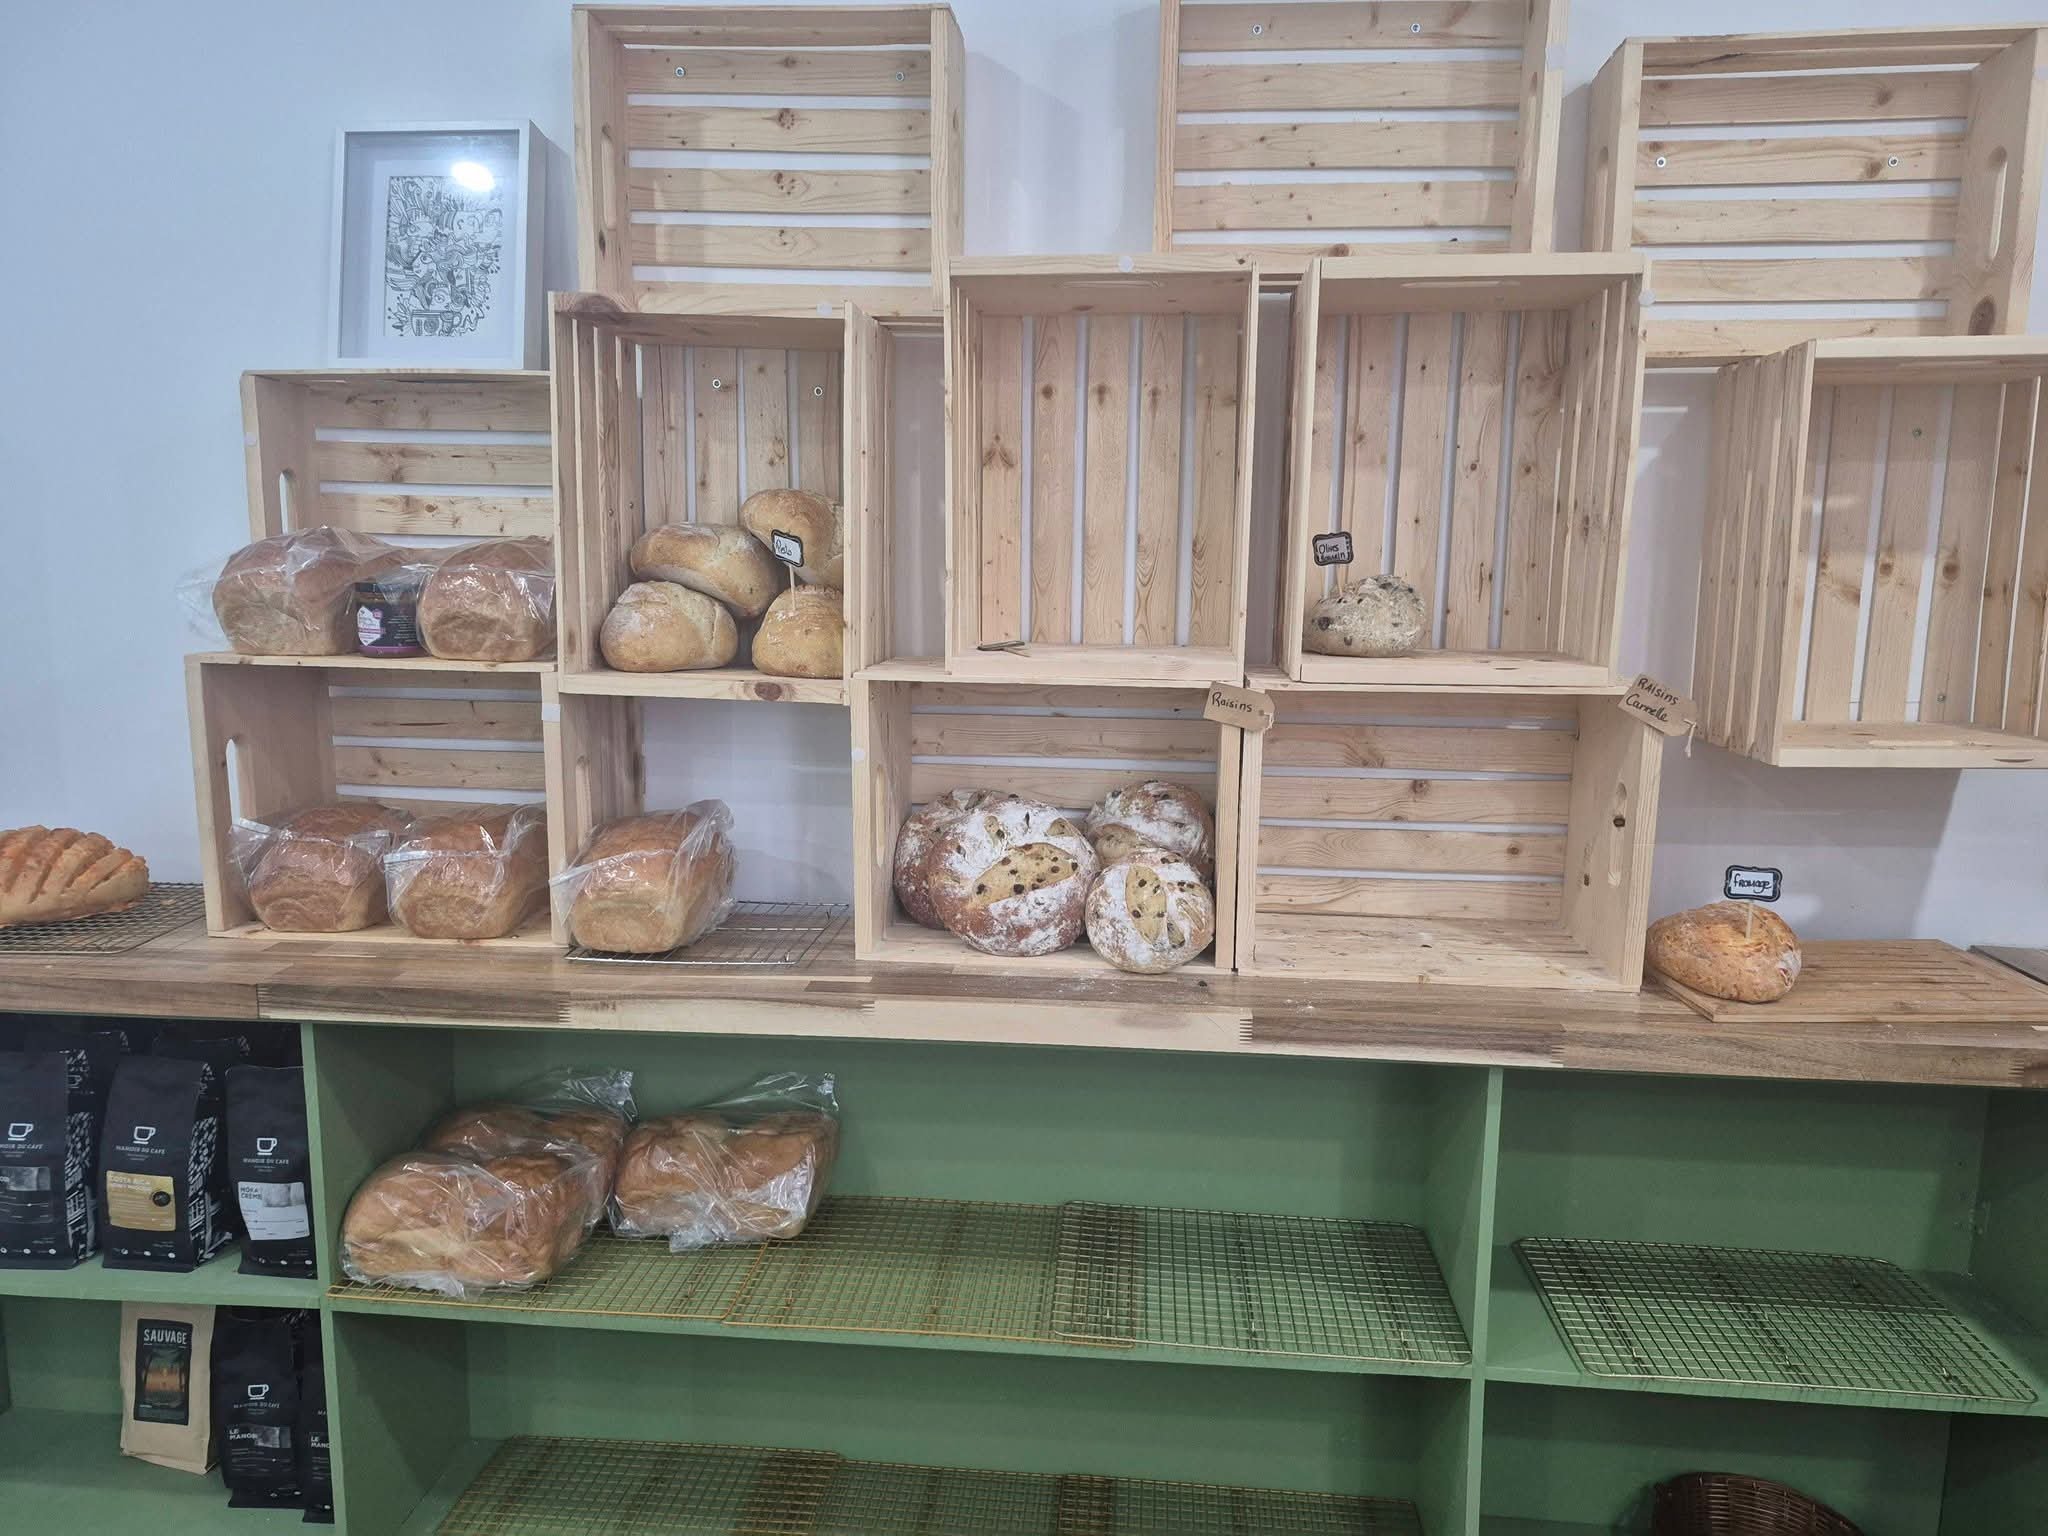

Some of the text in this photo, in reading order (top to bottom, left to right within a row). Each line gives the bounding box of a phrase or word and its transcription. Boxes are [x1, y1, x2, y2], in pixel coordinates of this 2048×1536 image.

[1212, 691, 1252, 713] Raisins
[1733, 873, 1772, 894] fromage
[143, 1328, 187, 1345] SAUVAGE
